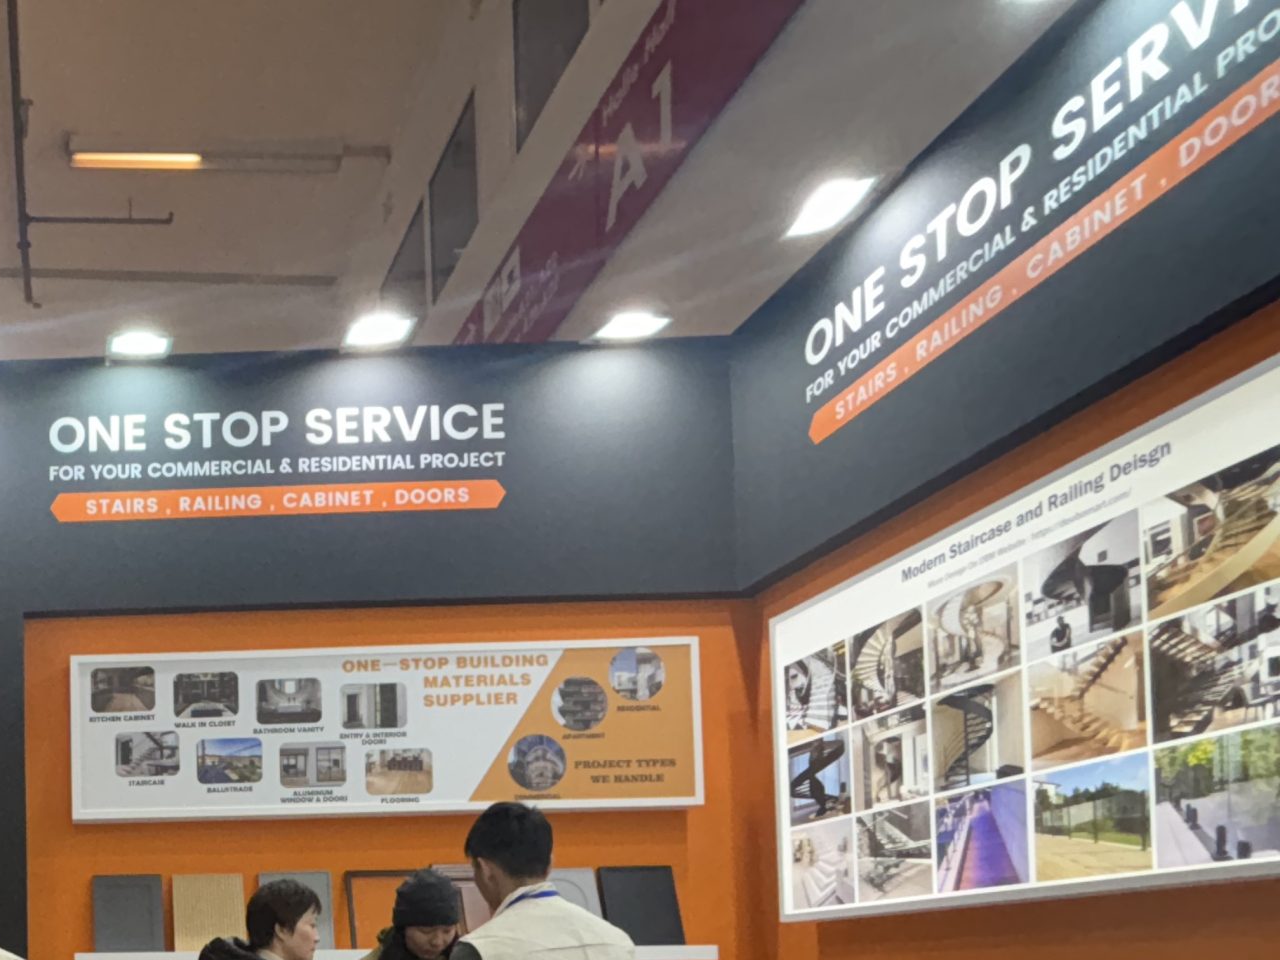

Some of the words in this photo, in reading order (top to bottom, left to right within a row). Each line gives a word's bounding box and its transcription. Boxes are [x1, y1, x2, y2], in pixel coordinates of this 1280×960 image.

[804, 266, 885, 365] ONE
[900, 143, 1032, 288] STOP
[1051, 0, 1251, 160] SERV
[805, 369, 834, 403] FOR
[837, 331, 881, 376] YOUR
[886, 225, 1016, 339] COMMERCIAL
[1021, 206, 1037, 232] &
[1043, 71, 1208, 215] RESIDENTIAL
[834, 361, 898, 420] STAIRS
[915, 283, 1004, 362] RAILING
[1026, 173, 1147, 279] CABINET
[49, 414, 146, 454] ONE
[164, 410, 289, 451] STOP
[305, 403, 506, 445] SERVICE
[49, 464, 85, 482] FOR
[90, 462, 142, 480] YOUR
[147, 458, 274, 479] COMMERCIAL
[279, 457, 292, 473] &
[298, 453, 414, 473] RESIDENTIAL
[420, 451, 506, 470] PROJECT
[86, 497, 159, 515] STAIRS
[179, 494, 262, 511] RAILING
[283, 490, 373, 508] CABINET
[394, 487, 470, 505] DOORS
[901, 552, 946, 583] Modern
[948, 517, 1012, 560] Staircase
[1016, 500, 1044, 527] and
[1047, 473, 1104, 513] Railing
[1109, 440, 1172, 483] Deisgn
[456, 654, 549, 669] BUILDING
[423, 673, 532, 688] MATERIALS
[423, 692, 518, 707] SUPPLIER
[574, 759, 632, 769] PROJECT
[636, 758, 677, 768] TYPES
[590, 775, 611, 784] WE
[614, 774, 665, 783] HANDLE
